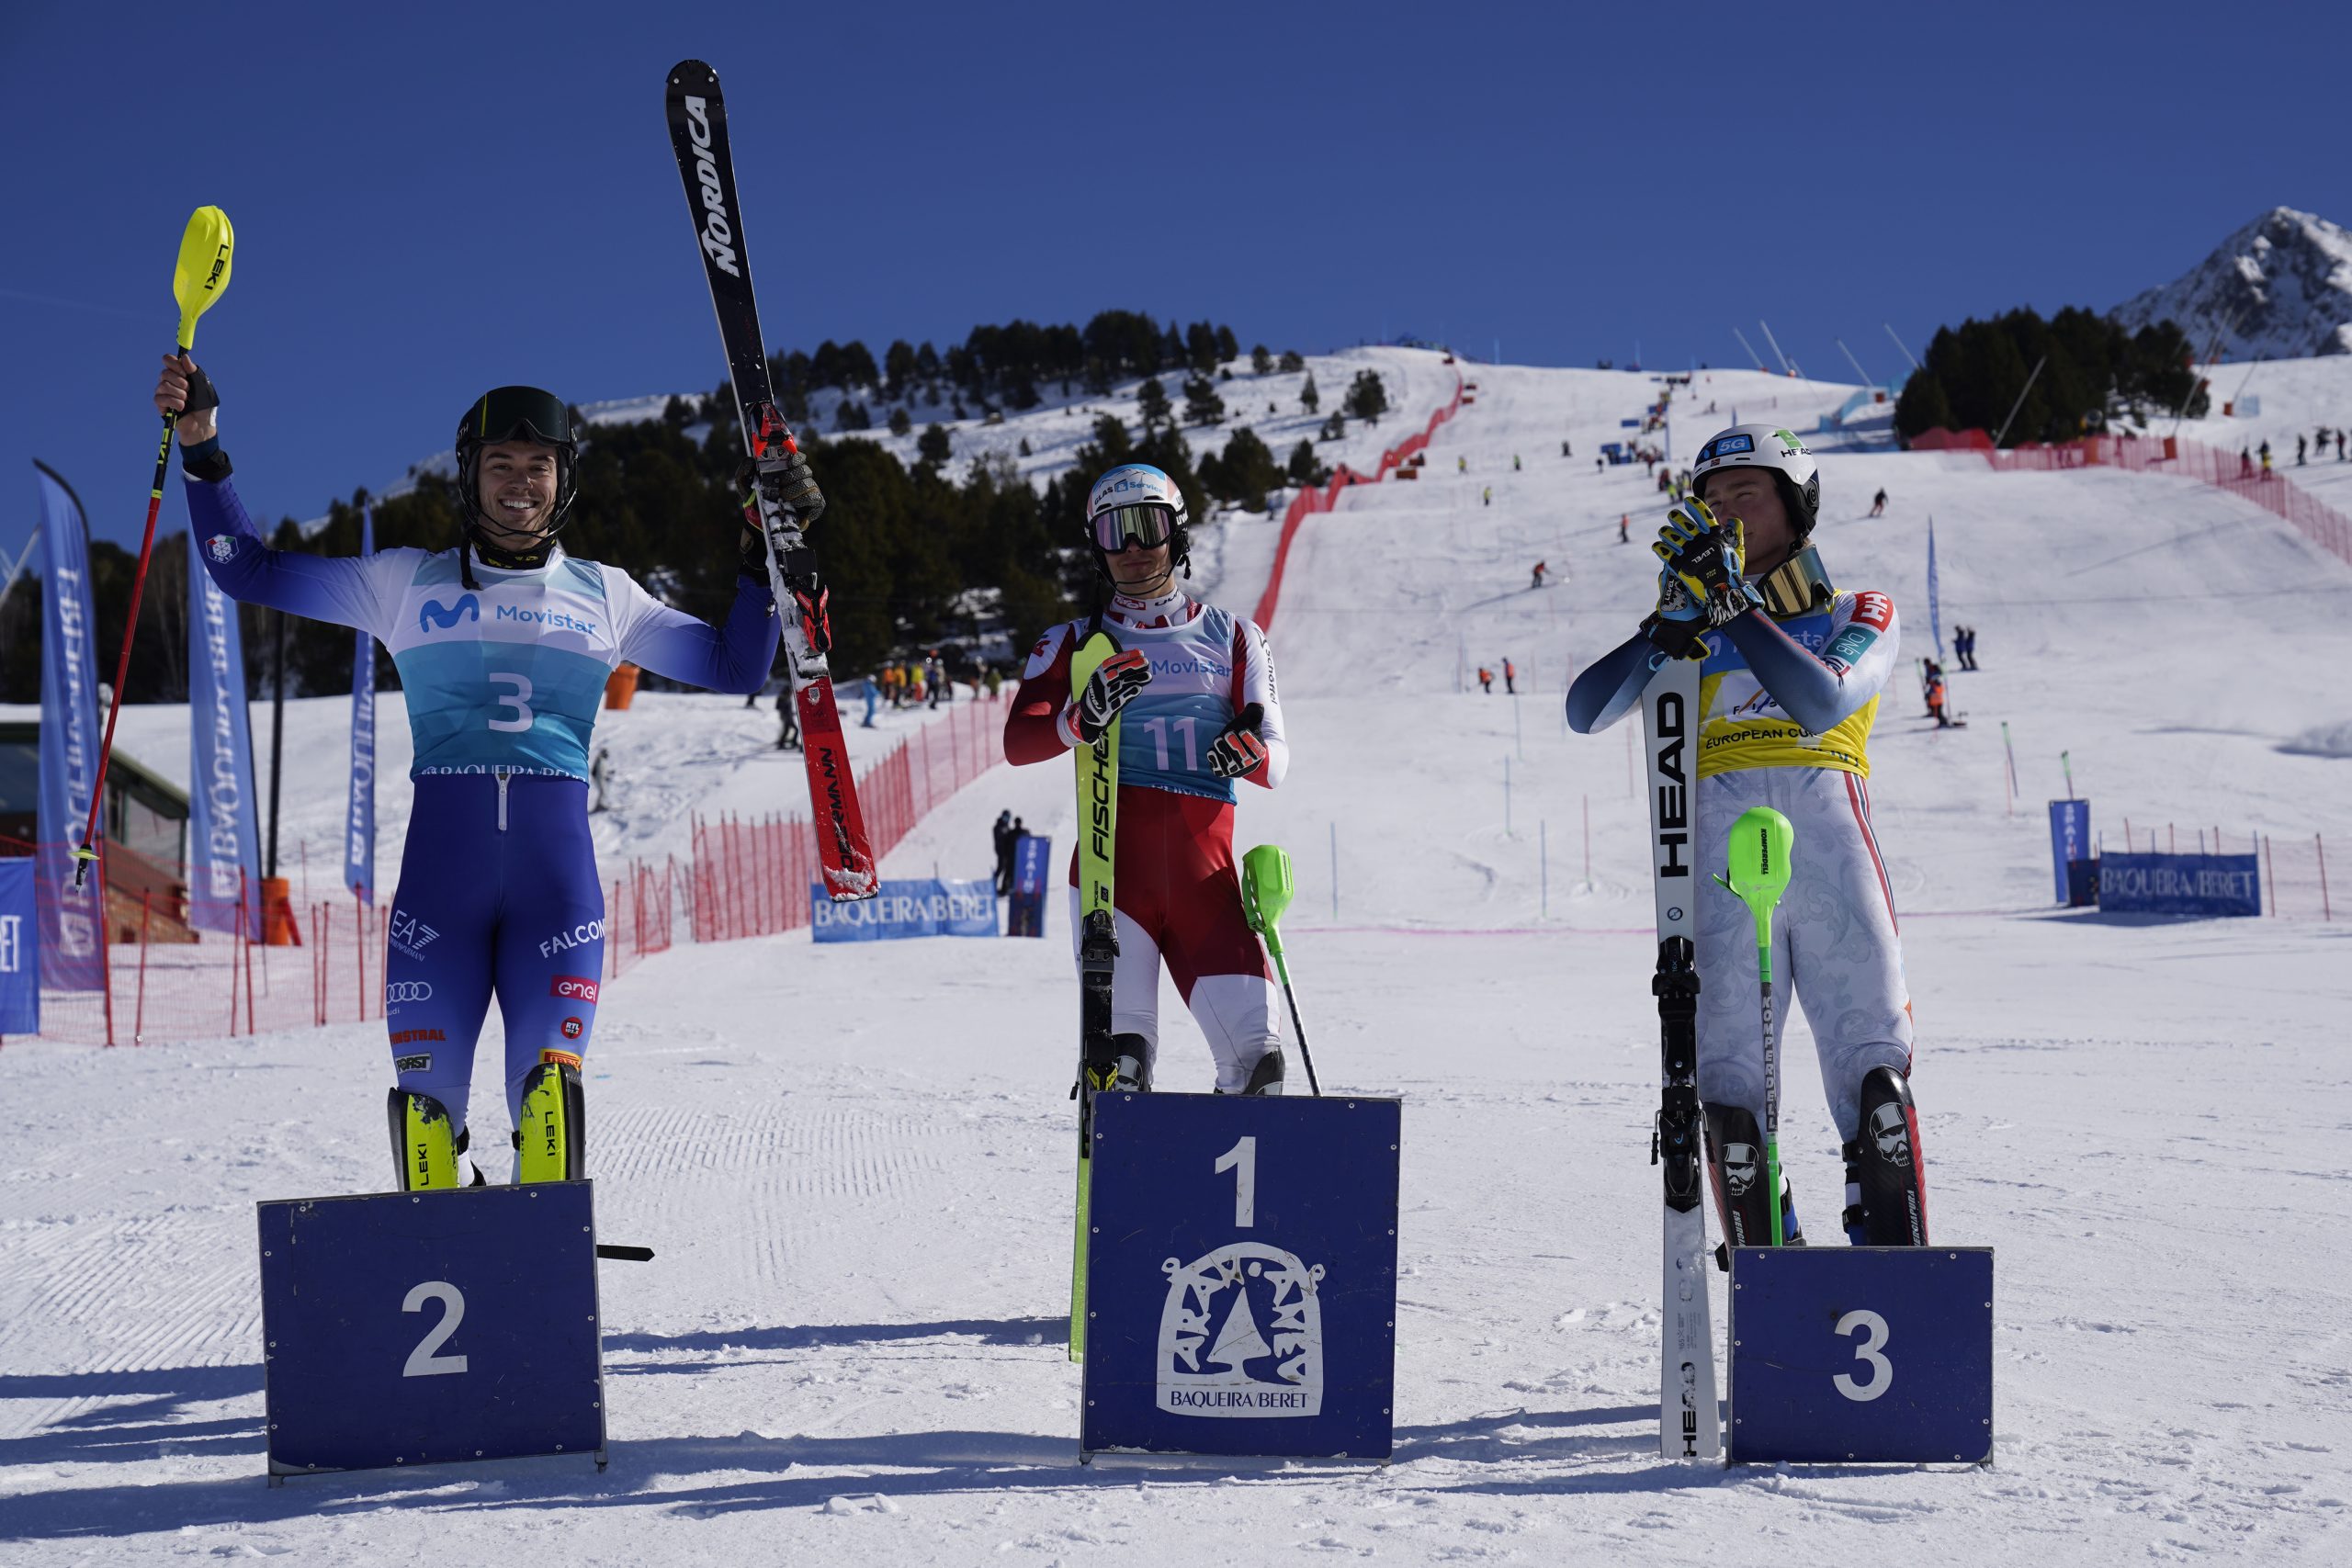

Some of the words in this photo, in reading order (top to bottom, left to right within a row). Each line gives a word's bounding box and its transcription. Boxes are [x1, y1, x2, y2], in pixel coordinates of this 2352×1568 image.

[684, 95, 740, 277] NORDICA
[204, 243, 229, 290] LEKI
[1719, 438, 1746, 452] 5G
[1094, 486, 1114, 505] GLAS
[1129, 480, 1164, 493] Service
[1691, 547, 1715, 564] LEVEL
[1664, 579, 1676, 601] LEVEL
[1860, 593, 1888, 622] HH
[496, 604, 595, 635] Movistar
[1836, 632, 1866, 655] DNB
[1151, 659, 1233, 678] Movistar
[488, 672, 534, 733] 3
[1143, 716, 1198, 772] 11
[1705, 728, 1783, 750] EUROPEAN
[1656, 692, 1689, 878] HEAD
[819, 747, 854, 871] OBERMANN
[1760, 828, 1769, 874] KOMPERDELL
[2101, 867, 2255, 899] BAQUEIRA/BERET
[390, 909, 440, 951] EA7
[558, 980, 597, 1001] enel
[386, 1007, 401, 1016] udi
[565, 1021, 580, 1030] RTL
[1763, 996, 1778, 1132] KOMPERDELL
[545, 1111, 556, 1156] LEKI
[419, 1143, 429, 1186] LEKI
[1215, 1135, 1256, 1227] 1
[401, 1280, 469, 1377] 2
[1832, 1309, 1894, 1402] 3
[1170, 1391, 1309, 1409] BAQUEIRA/BERET
